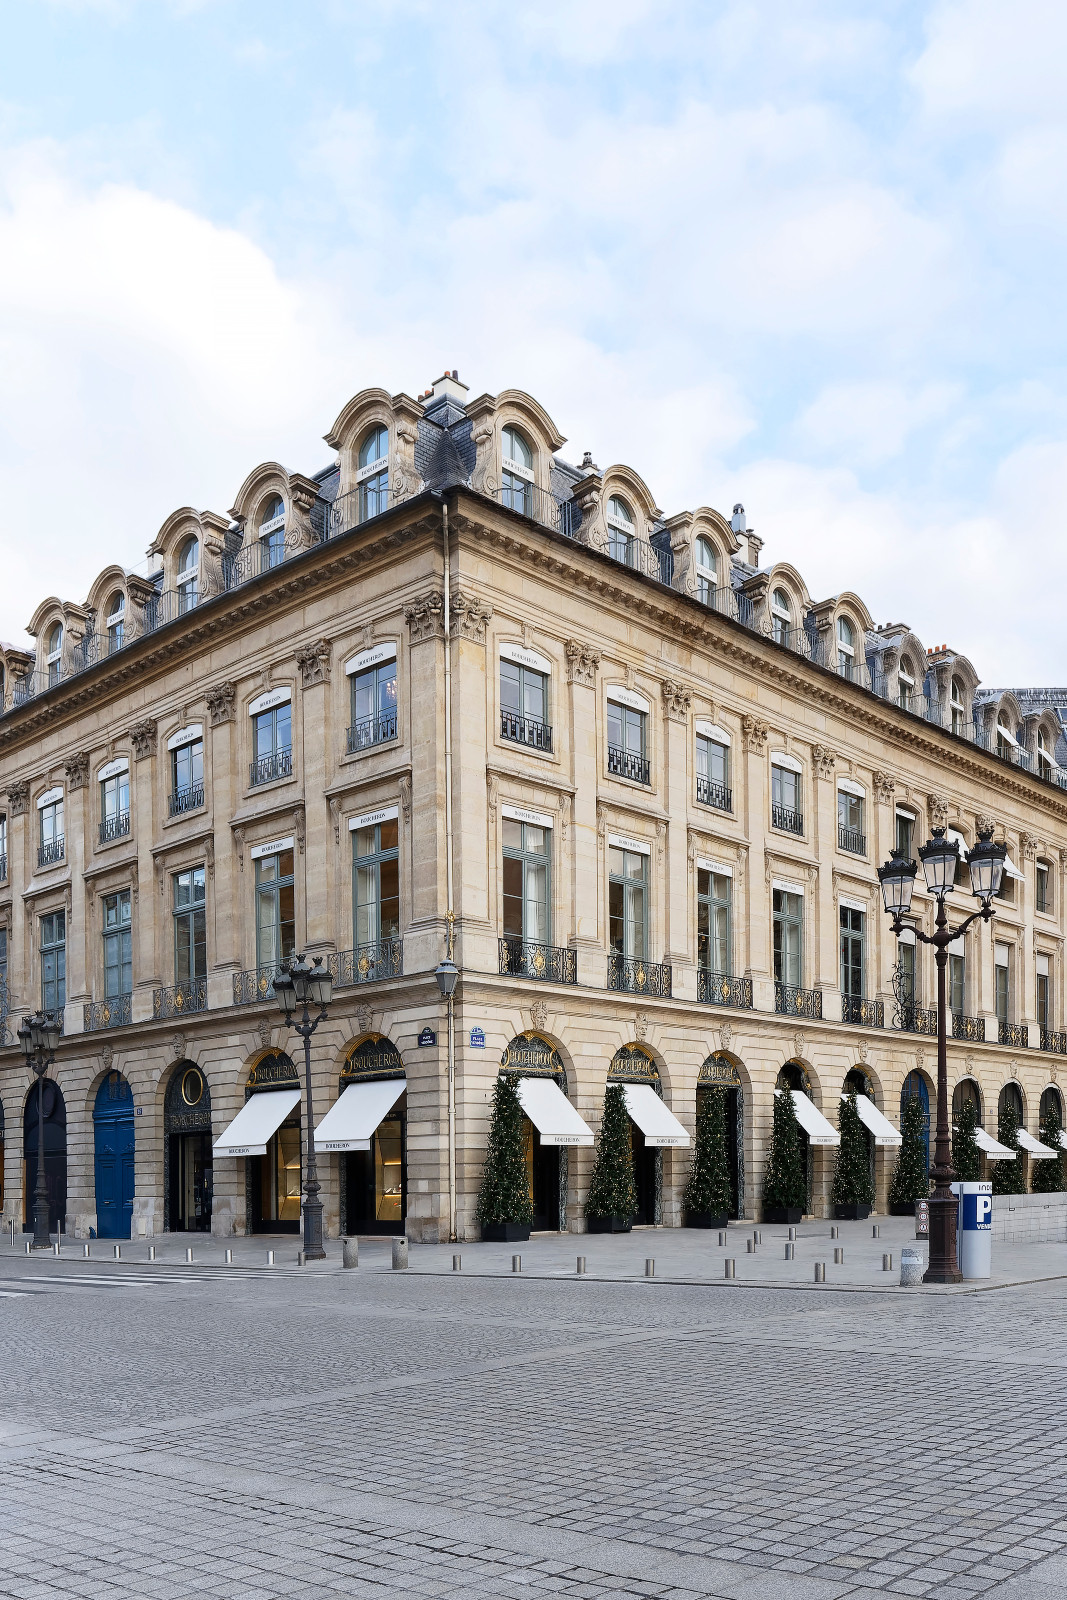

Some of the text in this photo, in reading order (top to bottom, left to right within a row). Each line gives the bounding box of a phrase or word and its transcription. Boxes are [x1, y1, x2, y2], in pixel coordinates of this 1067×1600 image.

[353, 1052, 400, 1070] BOUCHERON
[509, 1050, 551, 1065] BOUCHERON
[976, 1195, 992, 1223] P
